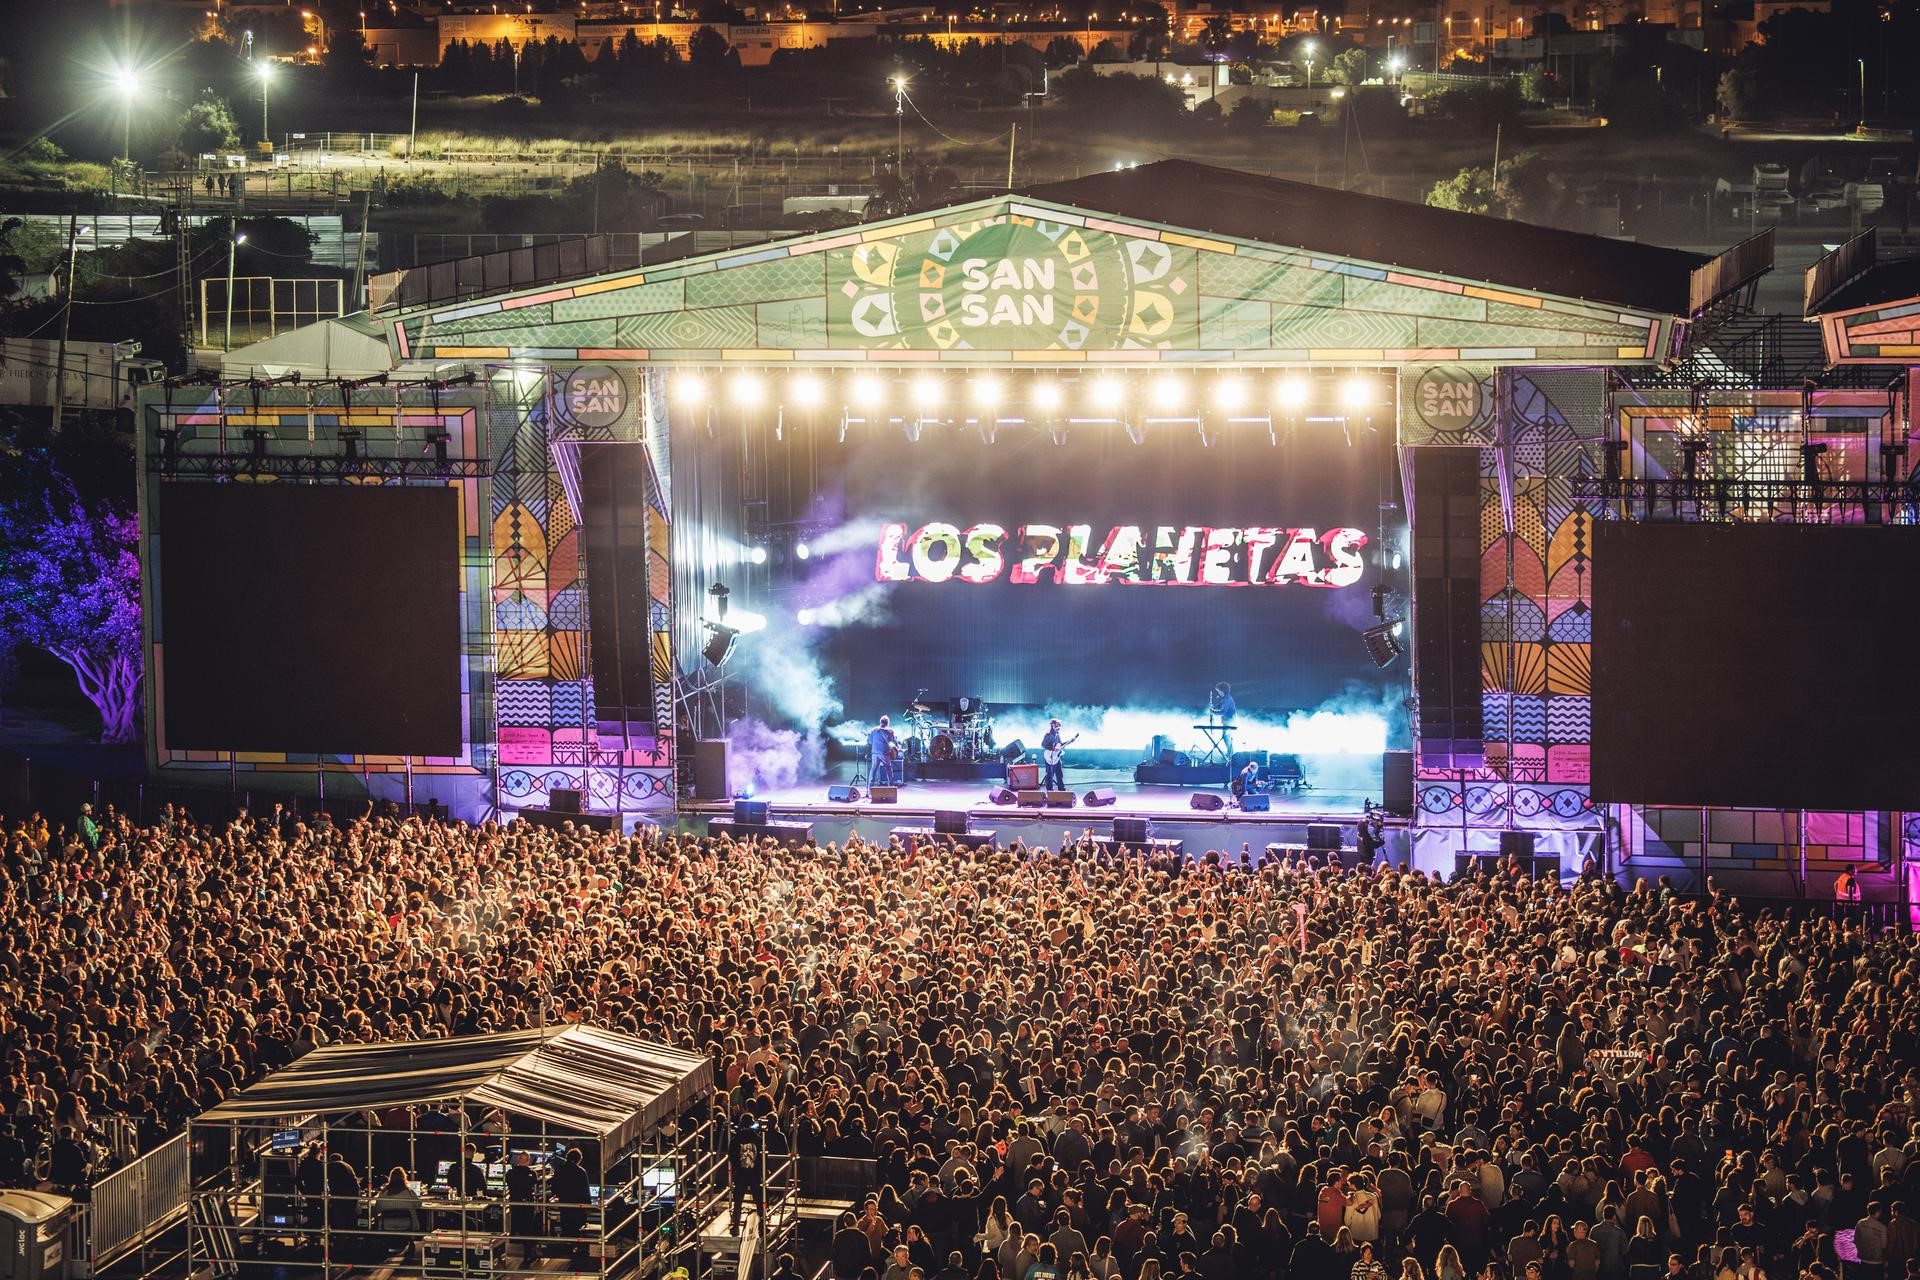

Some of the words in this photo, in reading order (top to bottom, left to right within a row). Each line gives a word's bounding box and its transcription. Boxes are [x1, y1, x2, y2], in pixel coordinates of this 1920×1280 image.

[961, 258, 1055, 290] SAN
[960, 294, 1054, 326] SAN
[572, 379, 619, 396] SAN
[1423, 382, 1473, 399] SAN
[572, 396, 620, 414] SAN
[1423, 399, 1474, 417] SAN
[877, 522, 1010, 584] LOS
[1010, 523, 1369, 588] PLANETAS
